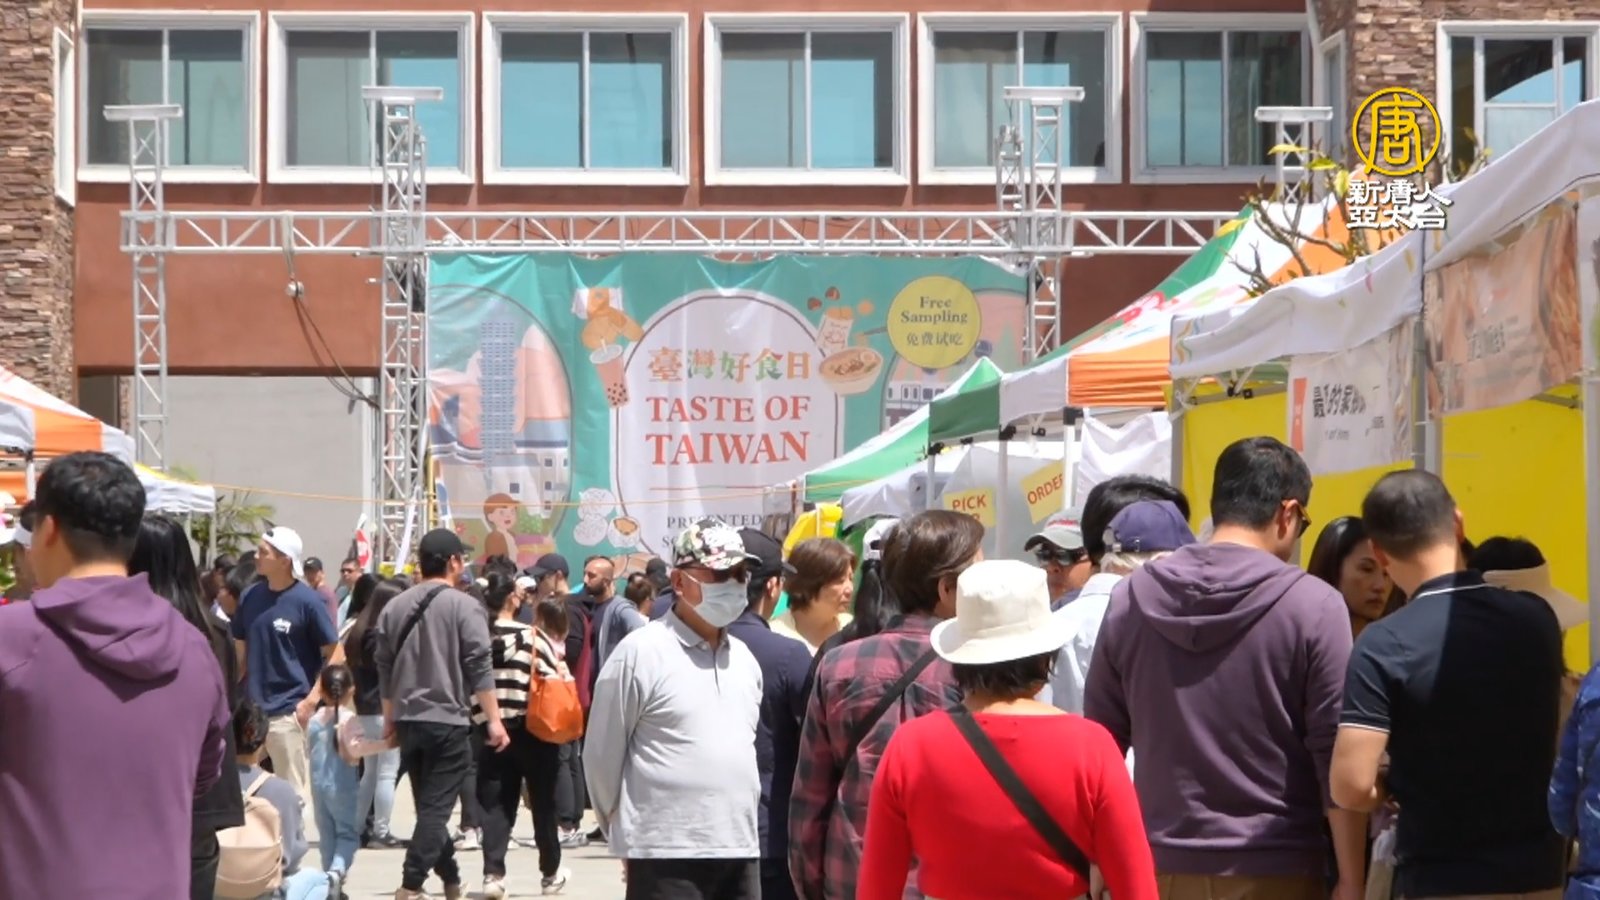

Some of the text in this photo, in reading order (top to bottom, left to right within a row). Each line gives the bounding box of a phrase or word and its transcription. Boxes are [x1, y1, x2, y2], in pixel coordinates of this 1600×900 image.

[920, 296, 952, 309] Free
[900, 310, 968, 325] Sampling
[648, 346, 811, 383] 臺灣好食日
[646, 396, 811, 422] TASTE OF
[645, 431, 811, 465] TAIWAN
[952, 494, 987, 511] PICK
